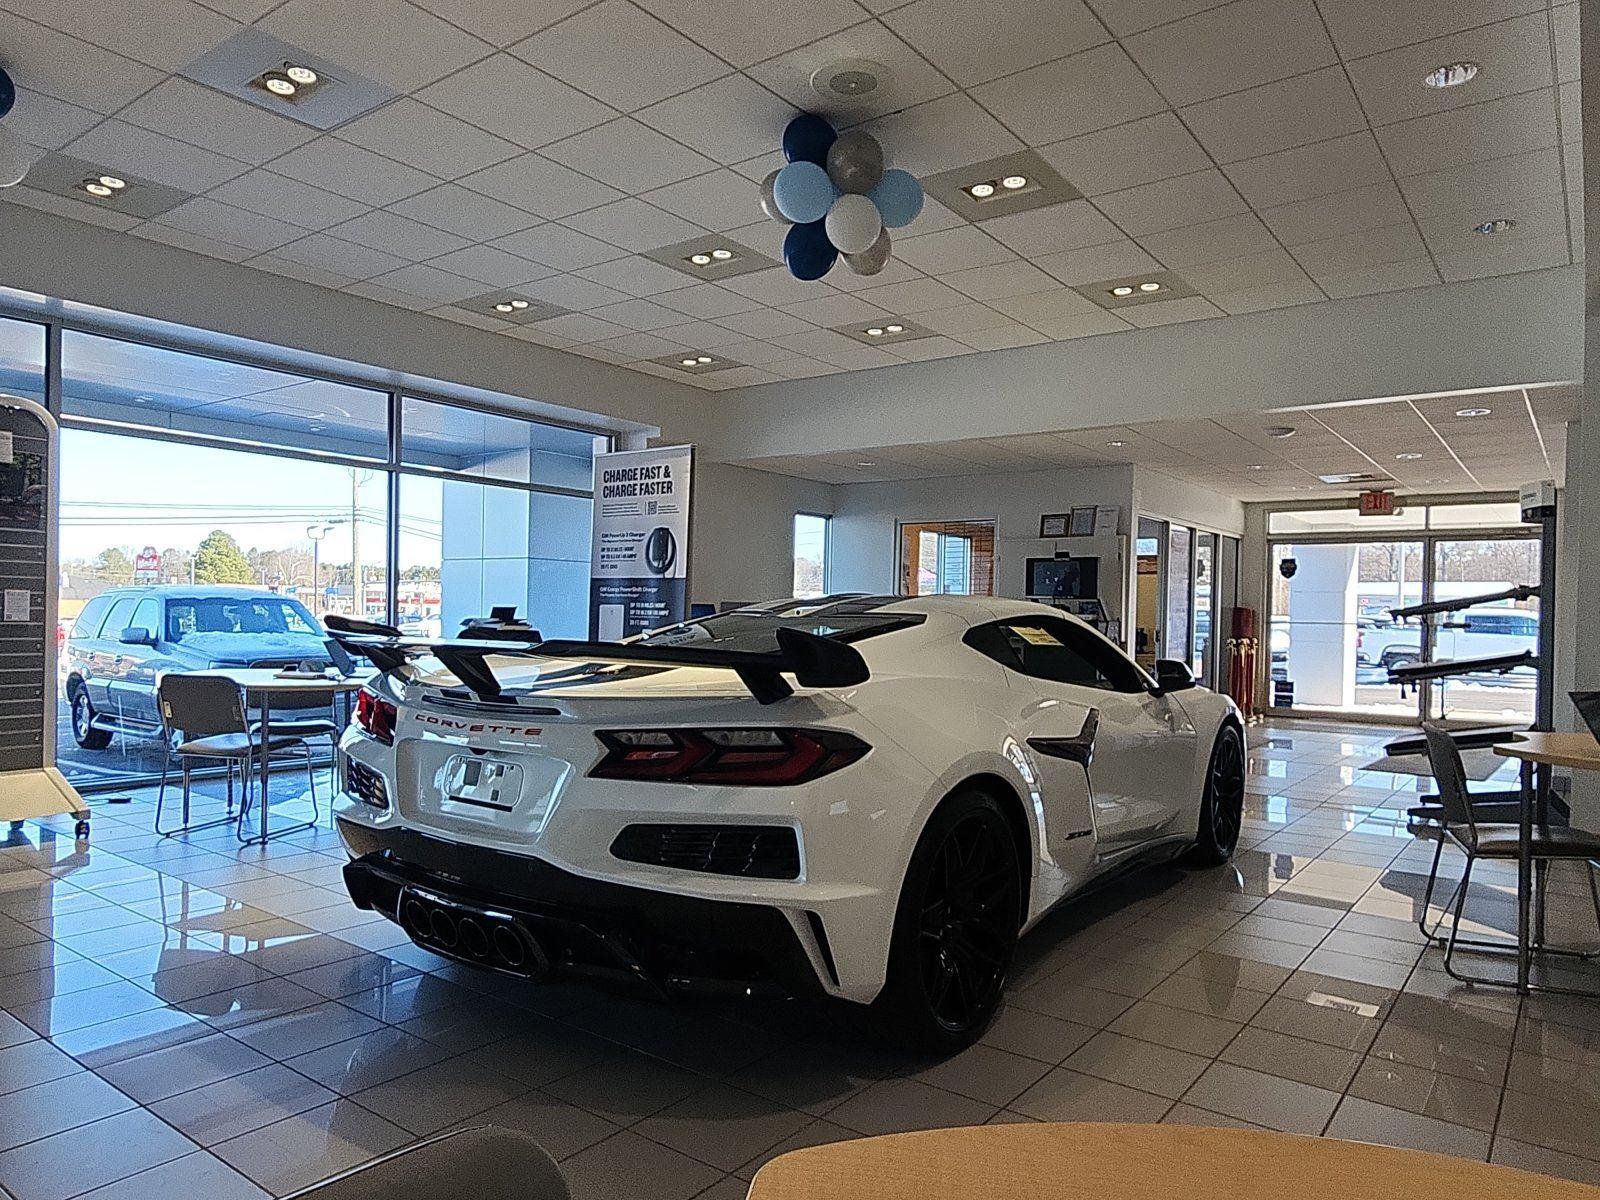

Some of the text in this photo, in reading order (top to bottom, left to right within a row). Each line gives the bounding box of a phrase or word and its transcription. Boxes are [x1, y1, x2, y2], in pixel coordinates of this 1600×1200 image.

[603, 465, 671, 483] CHARGE FAST &
[603, 481, 673, 498] CHARGE FASTER
[414, 714, 543, 736] CORVETTE
